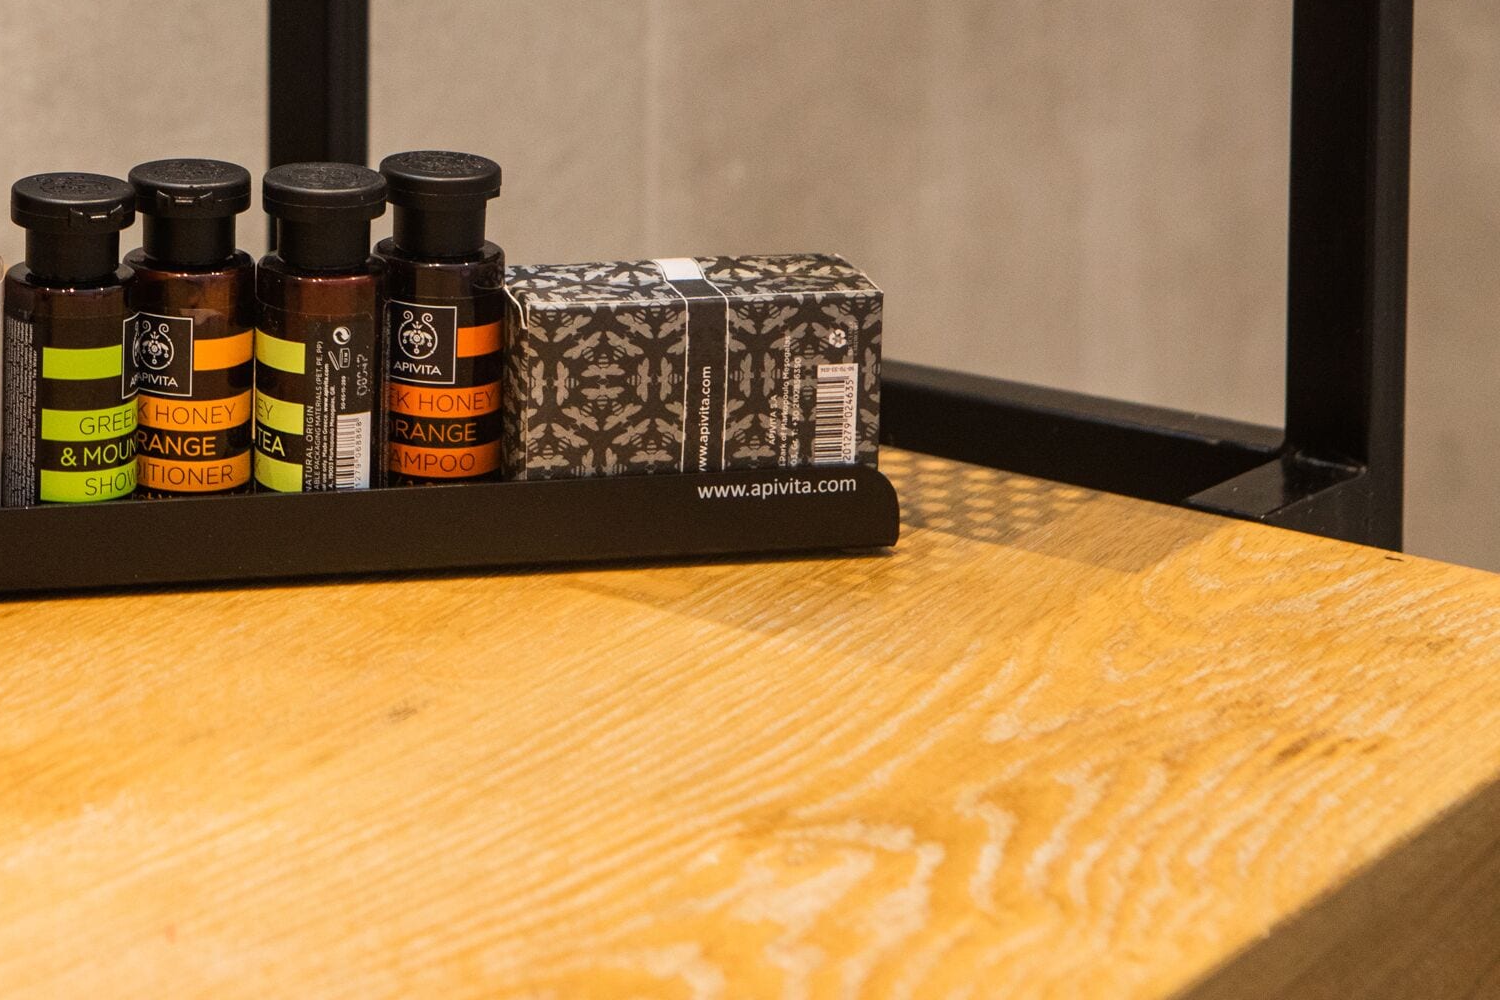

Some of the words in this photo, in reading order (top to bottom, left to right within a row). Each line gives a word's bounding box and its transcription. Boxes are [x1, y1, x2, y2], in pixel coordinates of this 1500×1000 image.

[393, 361, 442, 376] APIVITA
[156, 402, 236, 425] HONEY
[315, 386, 323, 426] MATERIALS
[419, 390, 495, 413] HONEY
[780, 382, 790, 430] Markopoulo
[843, 379, 854, 418] 024635
[306, 405, 314, 442] ORIGIN
[389, 419, 477, 444] RANGE
[768, 410, 778, 445] APIVITA
[780, 431, 787, 441] of
[60, 447, 77, 467] &
[257, 427, 286, 457] TEA
[314, 428, 322, 470] PACKAGING
[841, 423, 852, 461] 201279
[698, 476, 857, 500] www.apivita.com
